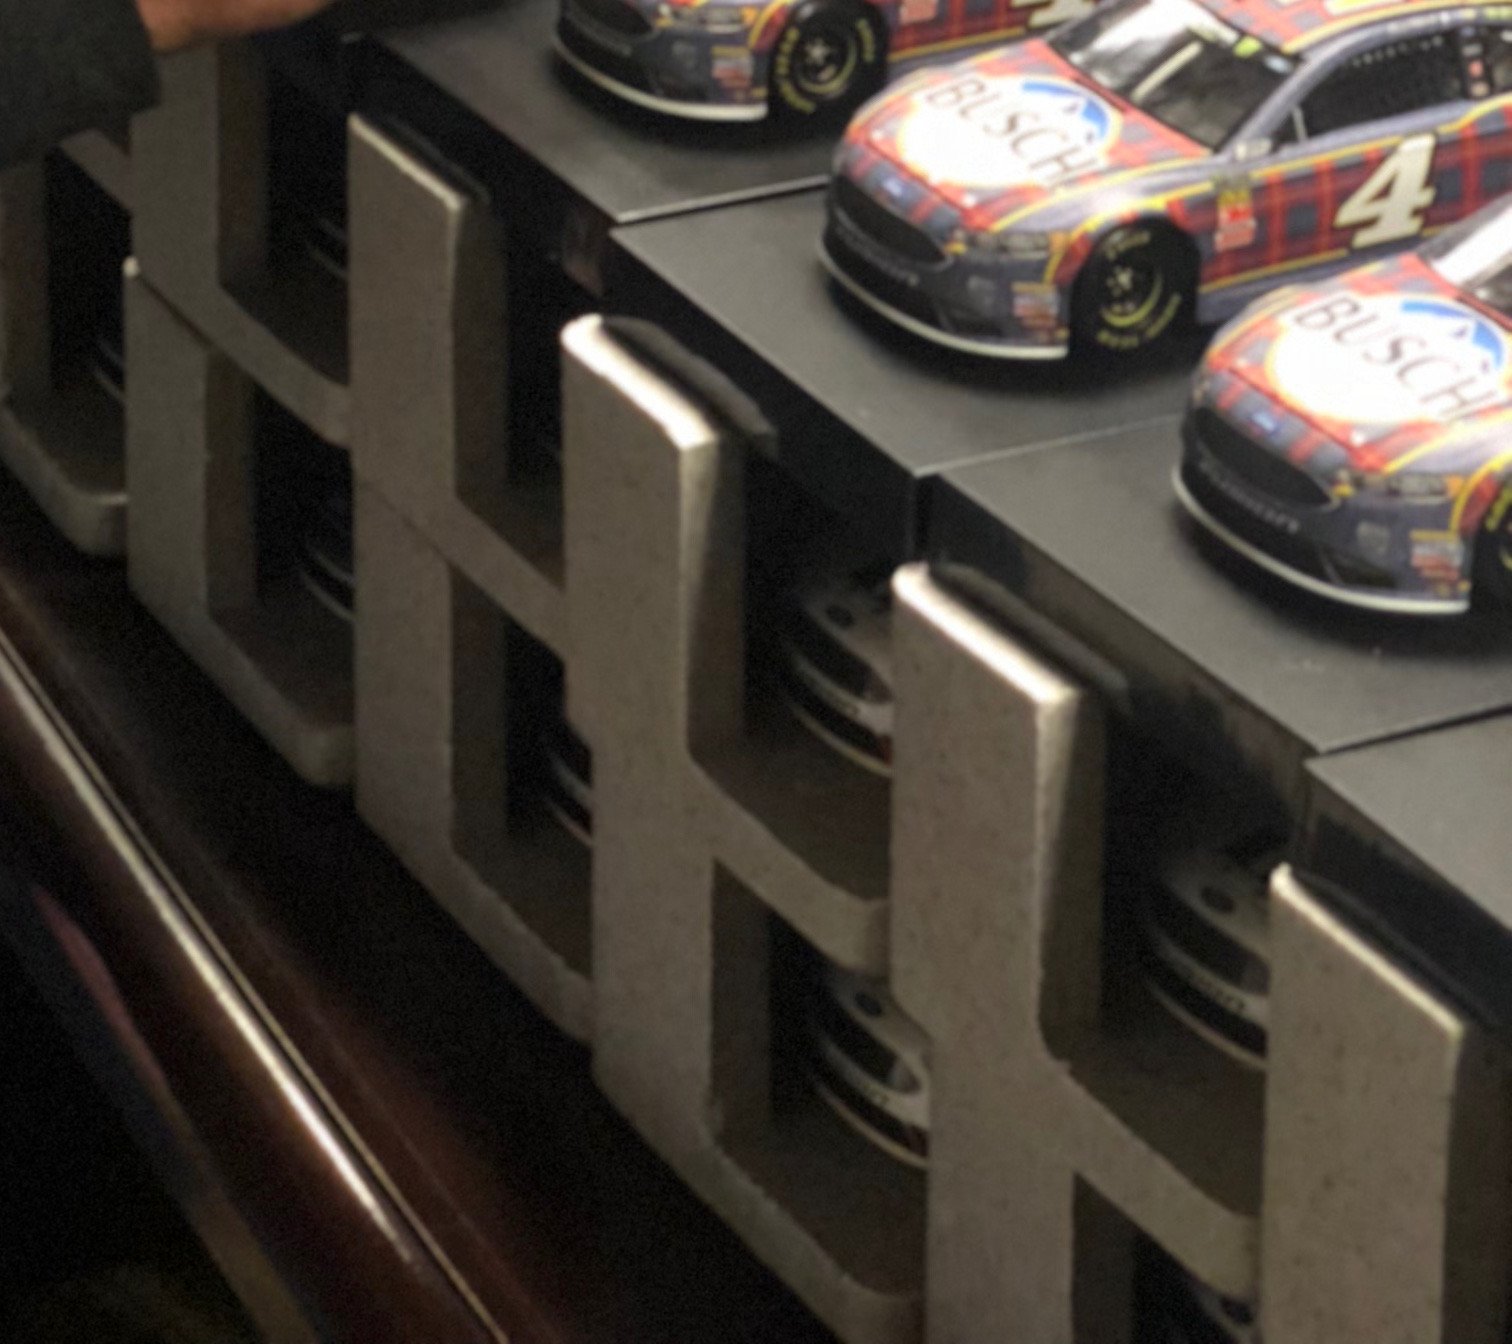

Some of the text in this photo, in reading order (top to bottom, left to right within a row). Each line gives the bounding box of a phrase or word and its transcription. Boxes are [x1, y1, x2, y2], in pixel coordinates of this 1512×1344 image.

[926, 76, 1104, 183] BUSCH
[1333, 132, 1438, 250] 4
[1293, 295, 1499, 420] BUSCH
